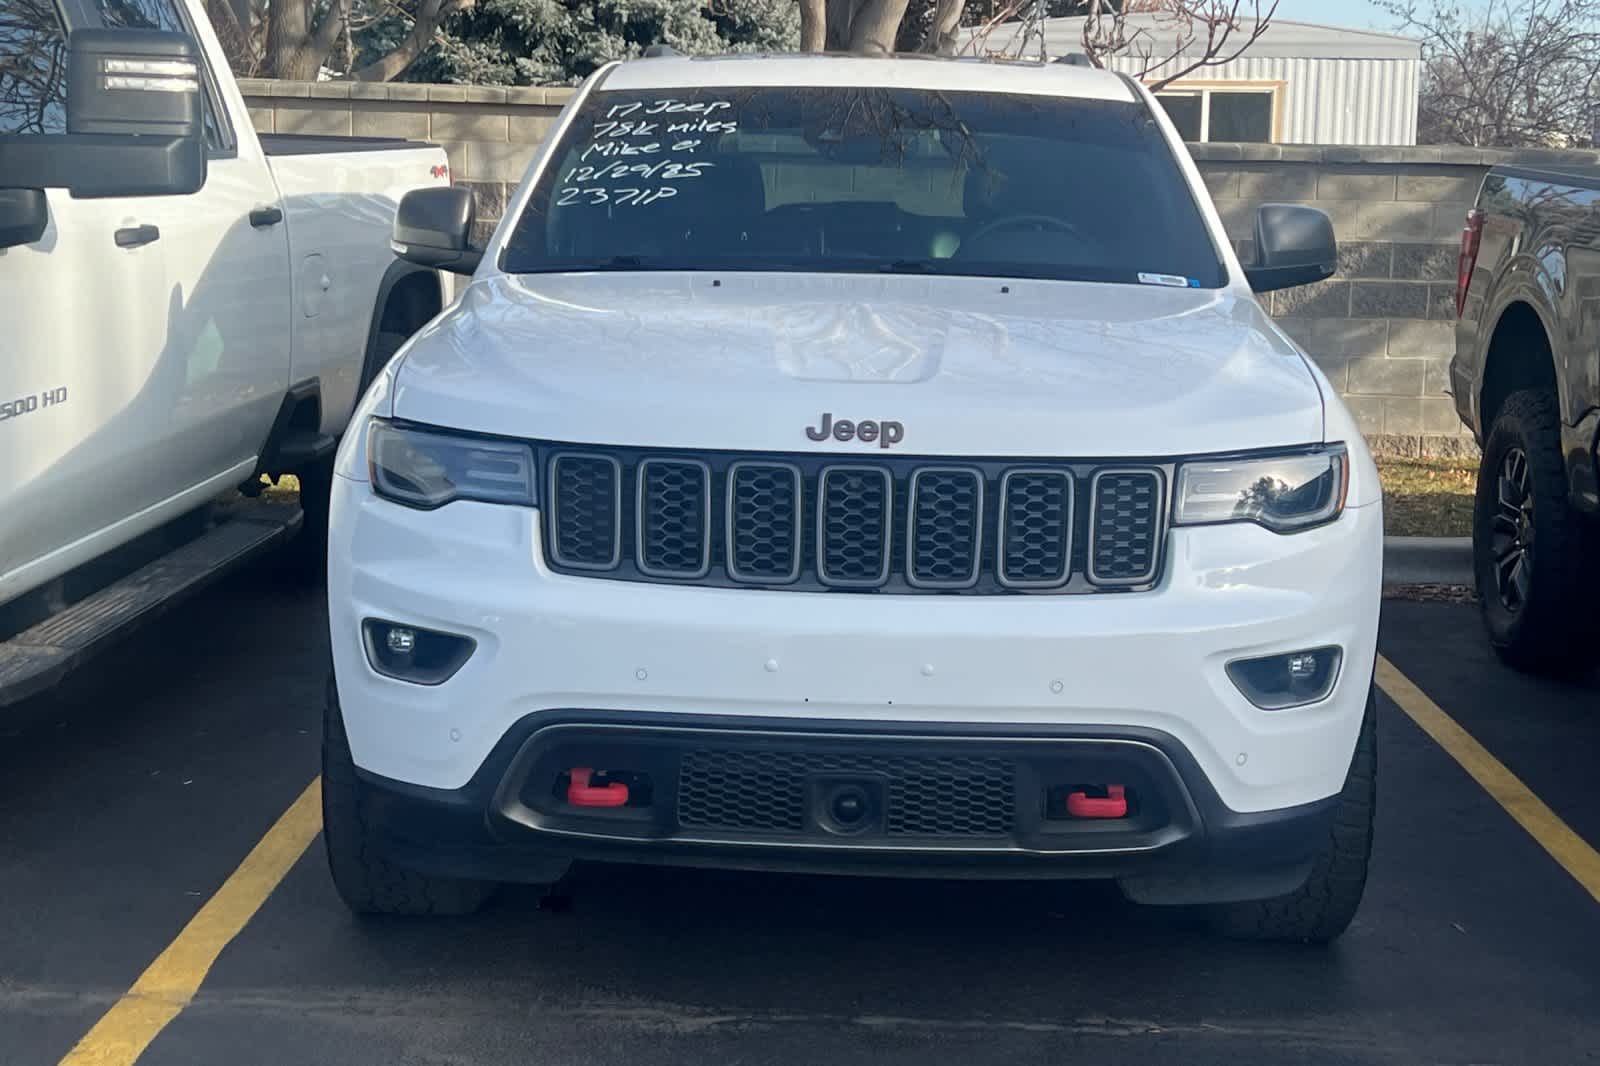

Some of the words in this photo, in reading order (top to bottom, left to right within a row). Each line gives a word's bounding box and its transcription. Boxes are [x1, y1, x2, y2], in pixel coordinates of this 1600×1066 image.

[581, 140, 661, 162] Mike
[556, 187, 678, 205] 2371P
[42, 386, 67, 408] HD
[805, 412, 905, 449] Jeep
